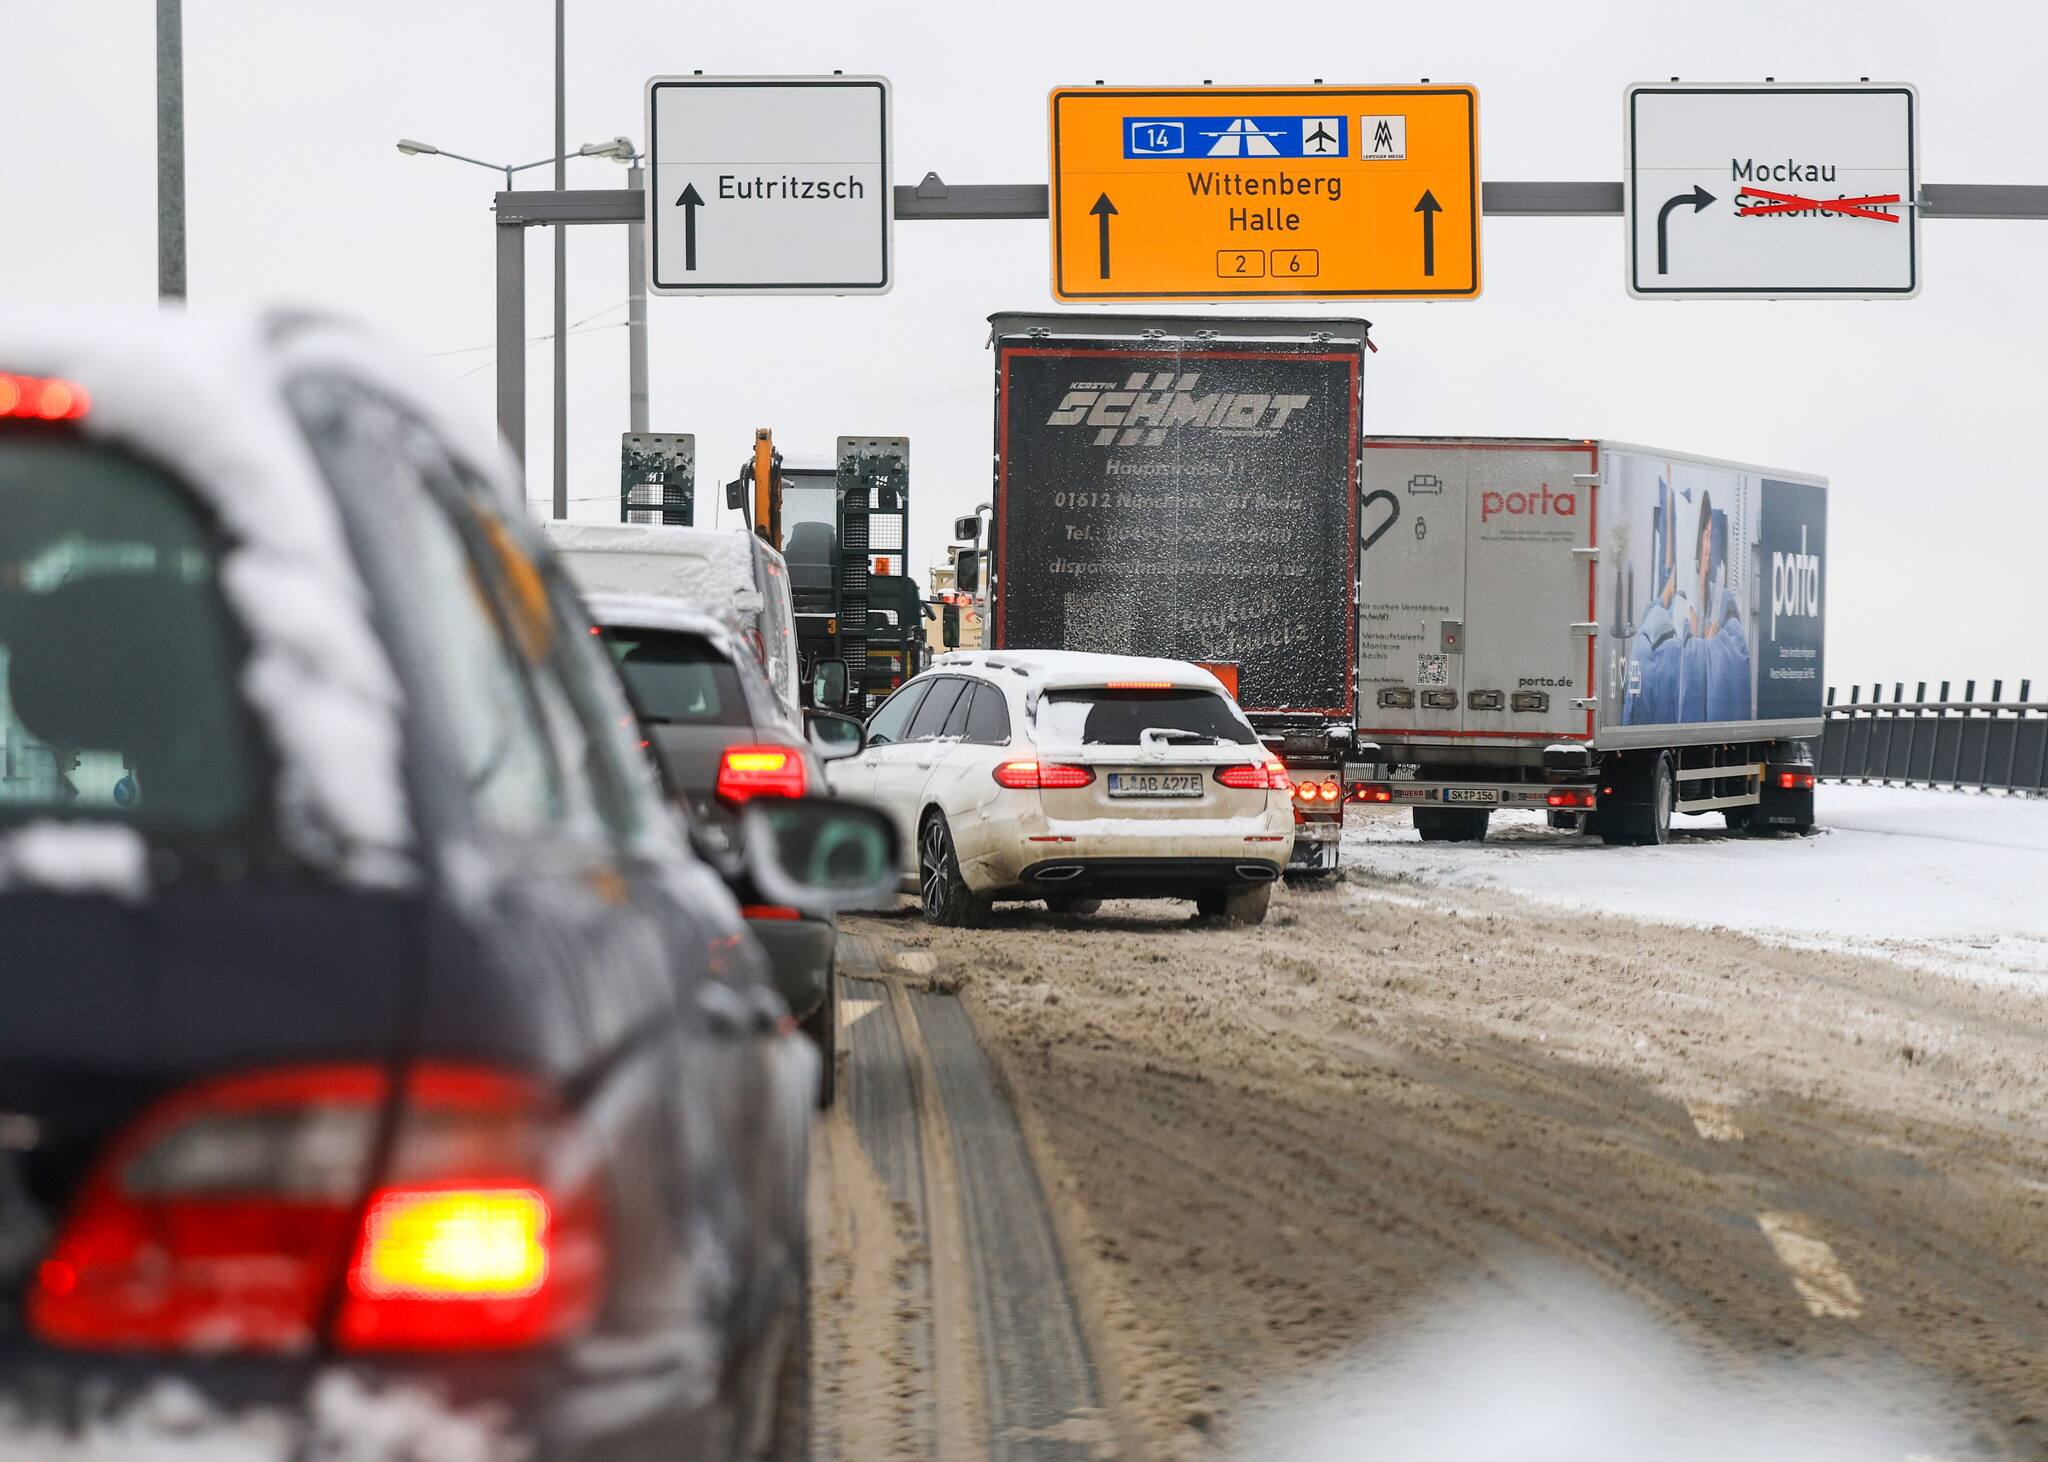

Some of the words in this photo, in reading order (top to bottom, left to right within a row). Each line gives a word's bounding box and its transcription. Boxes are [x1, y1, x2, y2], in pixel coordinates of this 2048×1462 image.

[1147, 128, 1169, 148] 14
[1732, 158, 1836, 182] Mockau
[719, 175, 864, 199] Eutritzsch
[1187, 172, 1342, 201] Wittenberg
[1229, 207, 1300, 231] Halle
[1235, 255, 1246, 273] 2
[1289, 254, 1300, 272] 6
[1046, 388, 1312, 430] SCHMIDT
[1054, 491, 1112, 509] 01612
[1481, 483, 1576, 524] porta
[1770, 524, 1819, 641] porta
[827, 618, 836, 634] 3
[1361, 631, 1425, 641] Verkaufstalente
[1361, 651, 1388, 660] Azubis
[1362, 642, 1400, 651] Monteure
[1519, 676, 1573, 688] porta.de
[1140, 777, 1158, 791] AB
[1161, 777, 1200, 791] 427E
[1451, 790, 1464, 800] SK
[1469, 791, 1476, 800] P
[1476, 791, 1494, 800] 156
